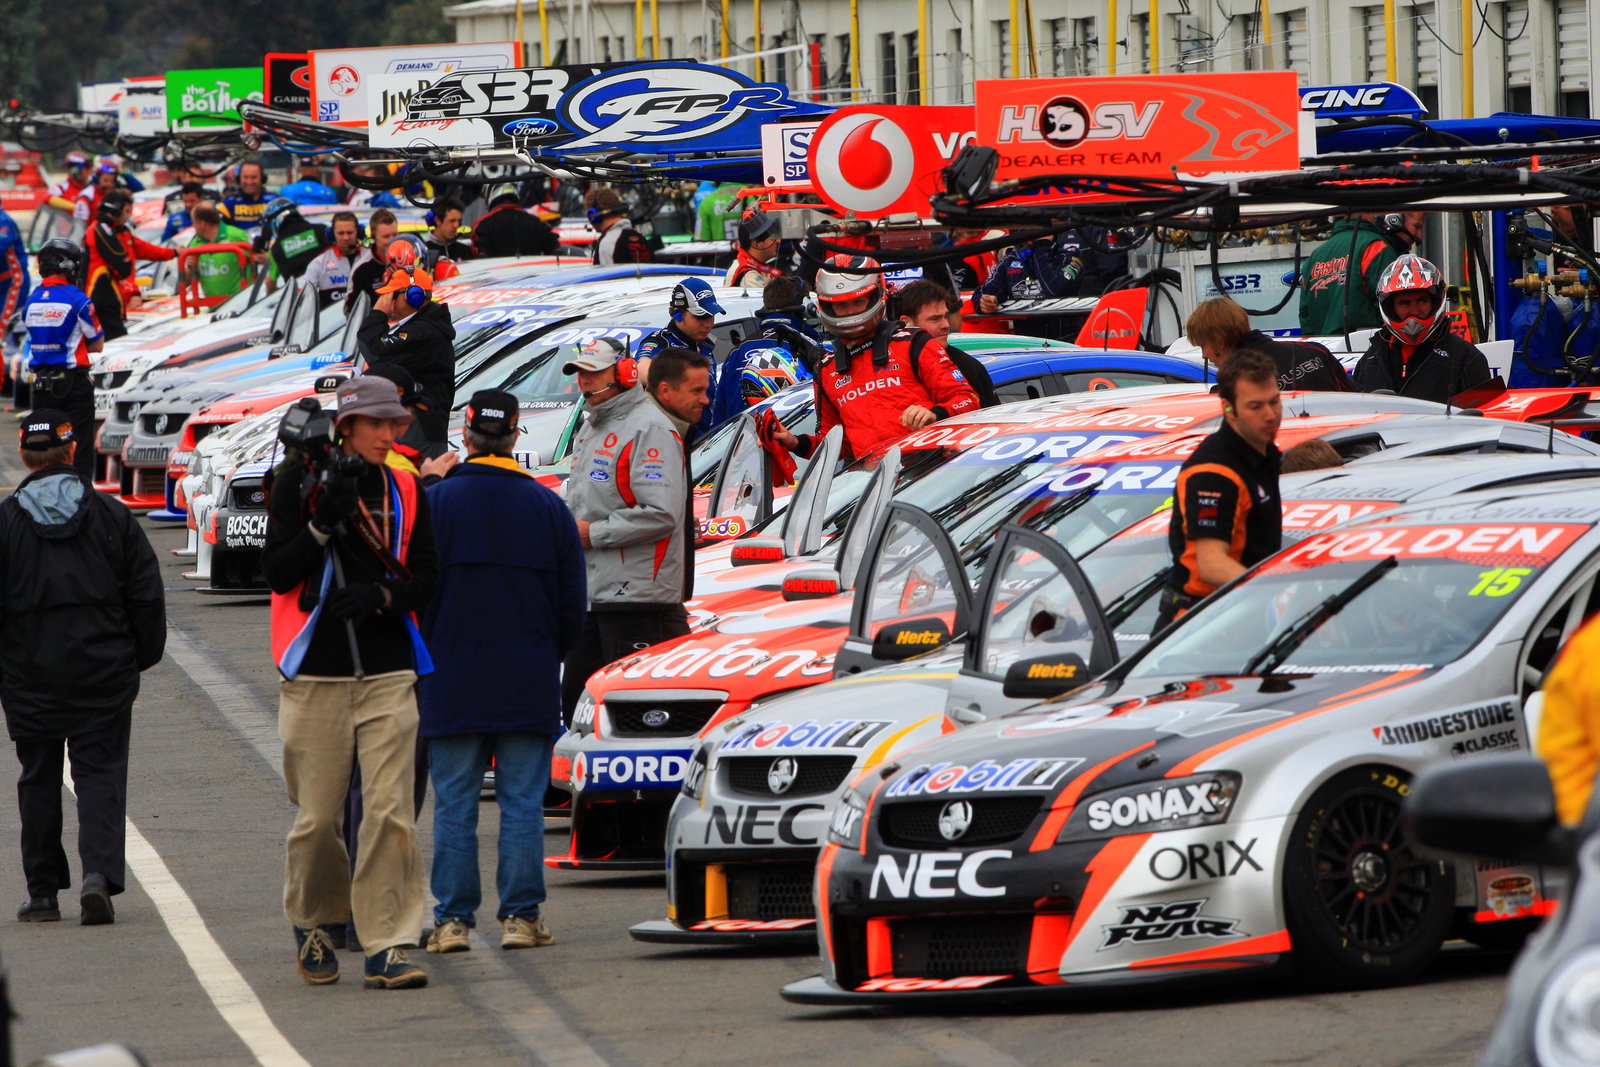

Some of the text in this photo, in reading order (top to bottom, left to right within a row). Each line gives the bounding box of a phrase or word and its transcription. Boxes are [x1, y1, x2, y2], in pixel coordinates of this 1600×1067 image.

[396, 62, 434, 72] DEMAND
[186, 85, 206, 96] the
[141, 107, 162, 115] AIR
[320, 102, 339, 115] SP
[512, 120, 549, 136] Ford
[1001, 151, 1161, 169] DEALER TEAM
[1095, 328, 1133, 339] MAN
[836, 376, 902, 407] HOLDEN
[481, 408, 505, 418] 2008
[530, 401, 555, 409] GOODS
[556, 401, 571, 409] NZ
[29, 423, 50, 432] 2008
[226, 515, 269, 535] BOSCH
[700, 520, 739, 535] dodo
[226, 535, 266, 548] Spark Plugs
[1284, 526, 1564, 563] HOLDEN
[1468, 567, 1532, 598] 15
[896, 630, 942, 645] Hertz
[1027, 663, 1077, 679] Hertz
[1381, 701, 1516, 746] BRIDGESTONE
[722, 719, 853, 749] Mobil
[1464, 728, 1519, 753] CLASSIC
[592, 755, 689, 784] FORD
[886, 758, 1037, 797] Mobil
[1087, 781, 1219, 831] SONAX
[704, 803, 825, 845] NEC
[1149, 838, 1264, 882] ORIX
[869, 849, 1013, 899] NEC
[1119, 897, 1208, 925] NO
[1100, 919, 1242, 949] FEAR
